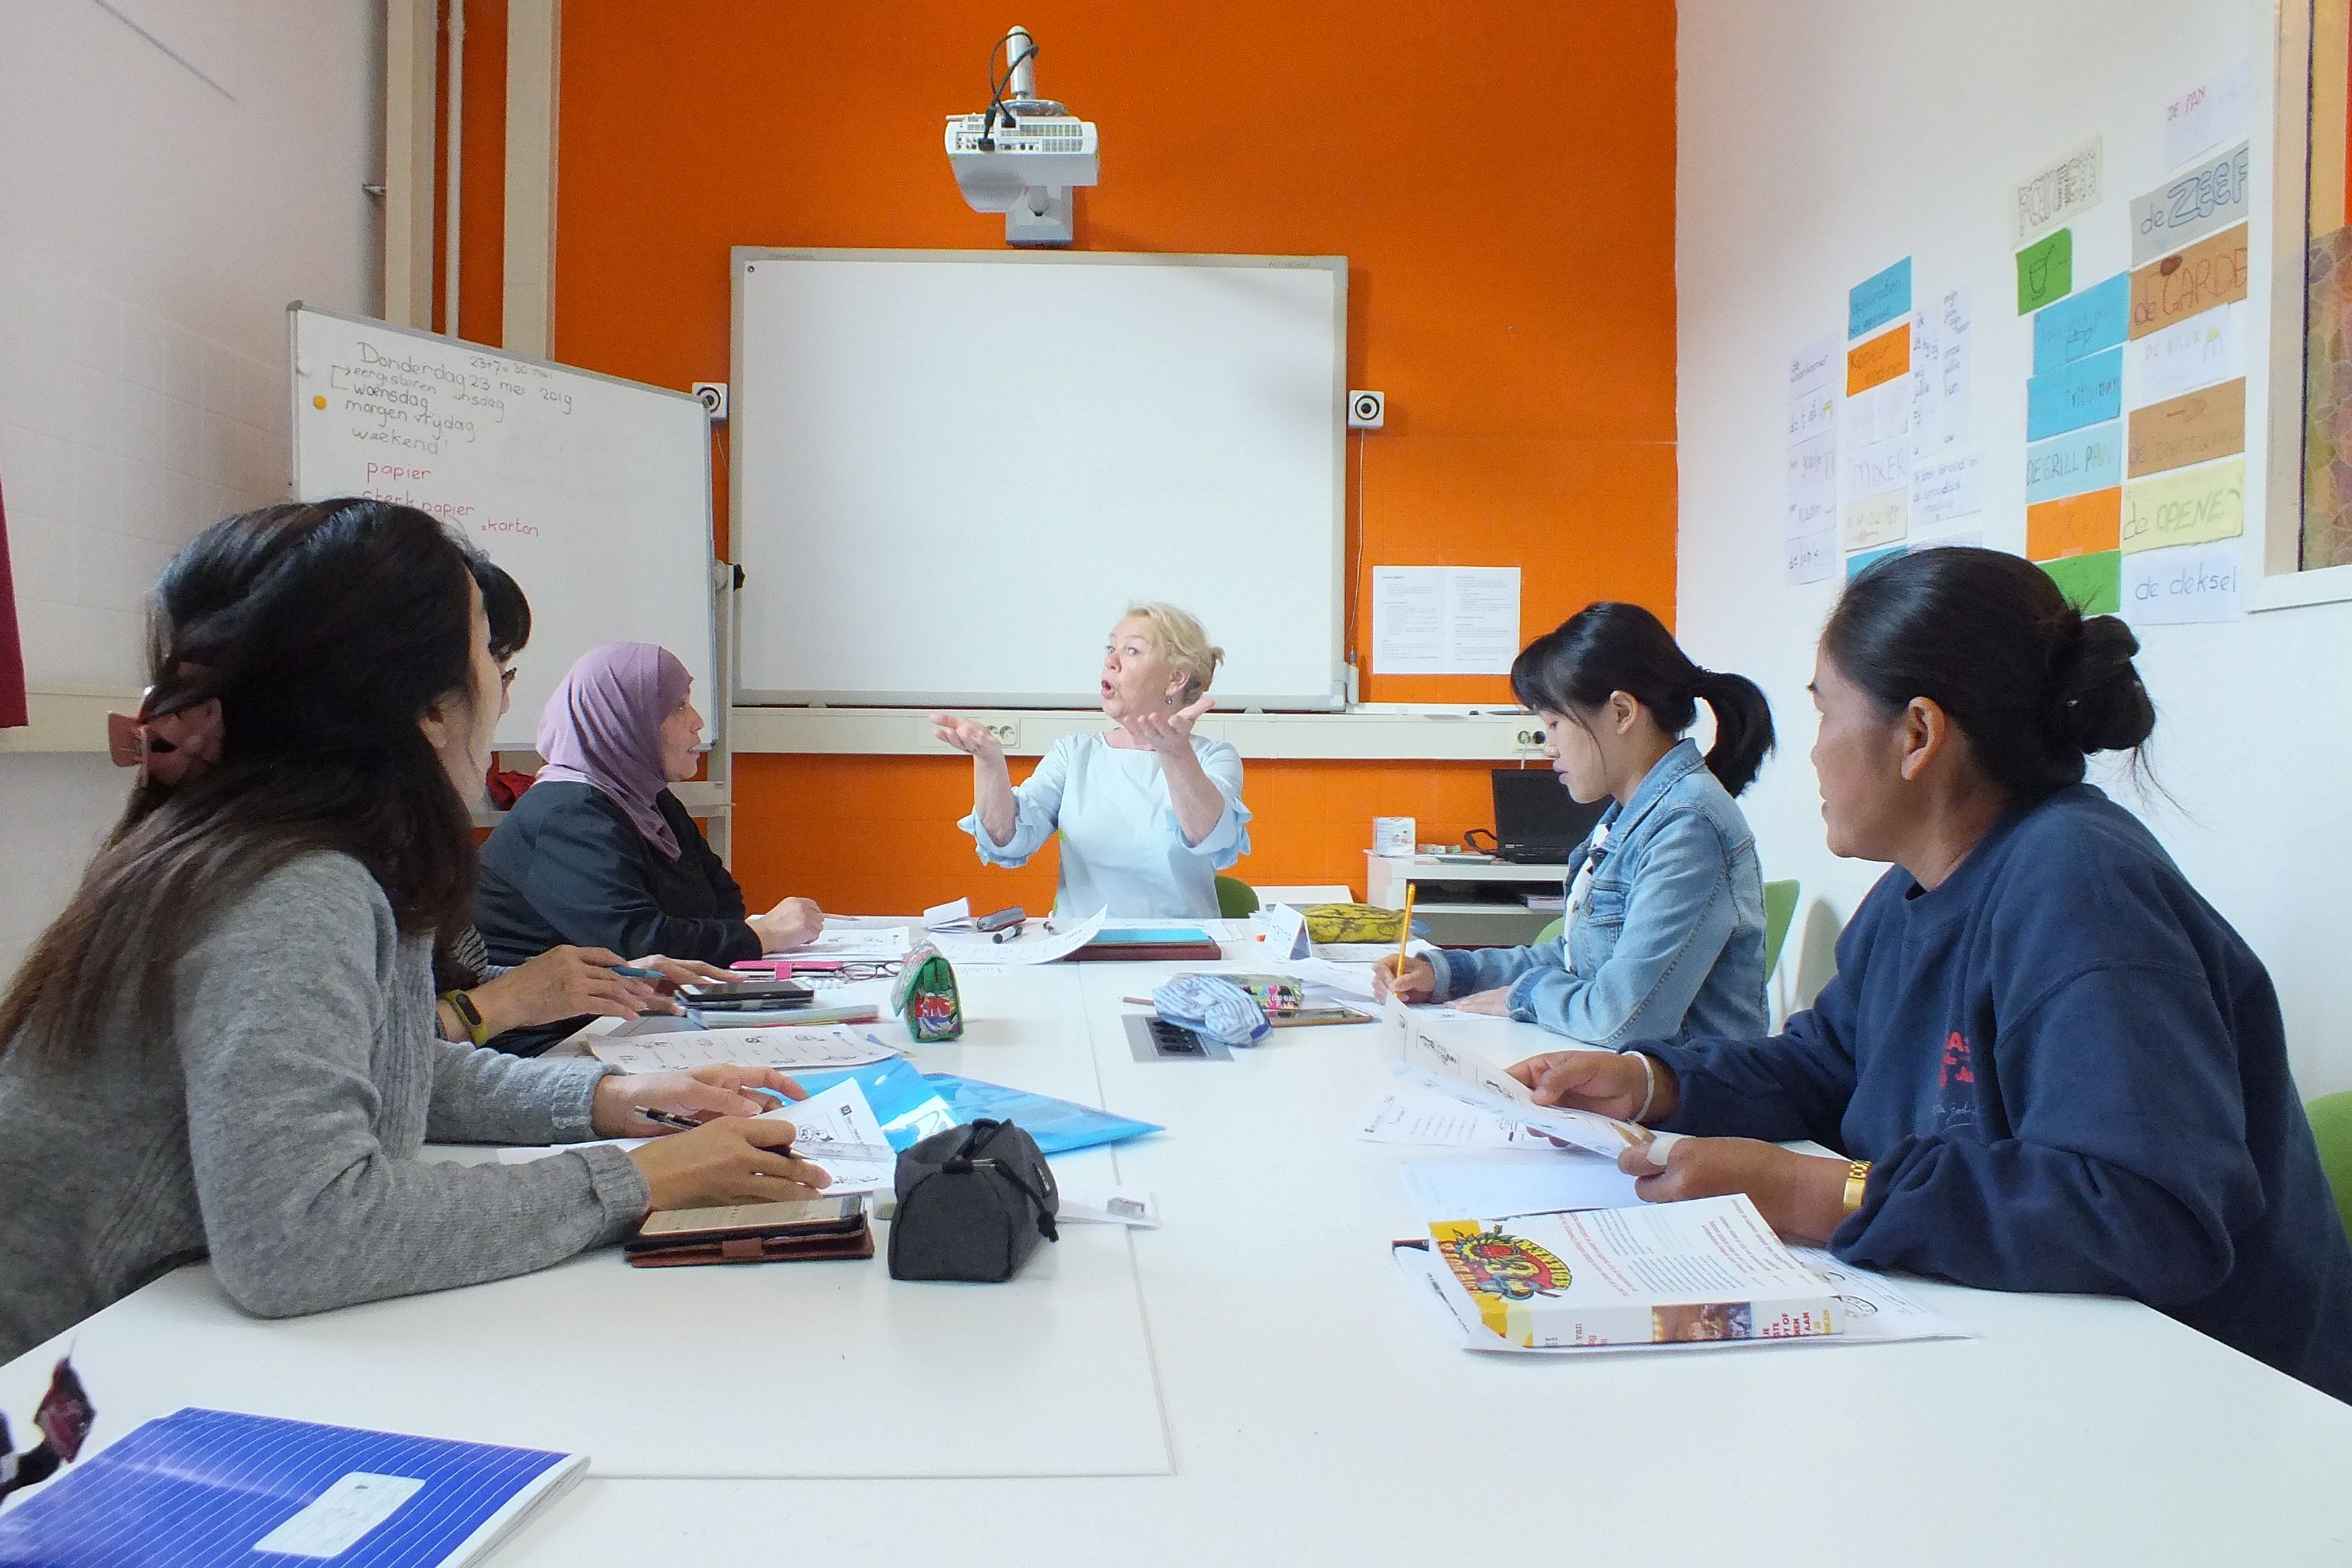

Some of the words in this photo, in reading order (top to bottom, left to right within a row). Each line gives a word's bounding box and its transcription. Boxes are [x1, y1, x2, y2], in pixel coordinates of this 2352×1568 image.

[2140, 203, 2165, 235] de
[2167, 147, 2249, 228] ZEEF
[2163, 246, 2248, 316] GARDE
[358, 342, 465, 393] Donderdag
[469, 375, 490, 391] 23
[500, 381, 525, 395] mei
[345, 400, 407, 427] morgen
[354, 384, 429, 414] woensdag
[352, 429, 438, 455] weekend
[367, 462, 432, 484] papier
[1853, 448, 1907, 491] MIXER
[422, 501, 475, 517] papier
[2123, 501, 2148, 540] de
[2135, 573, 2158, 600] de
[2169, 563, 2236, 595] deksel
[1782, 1313, 1789, 1325] OF
